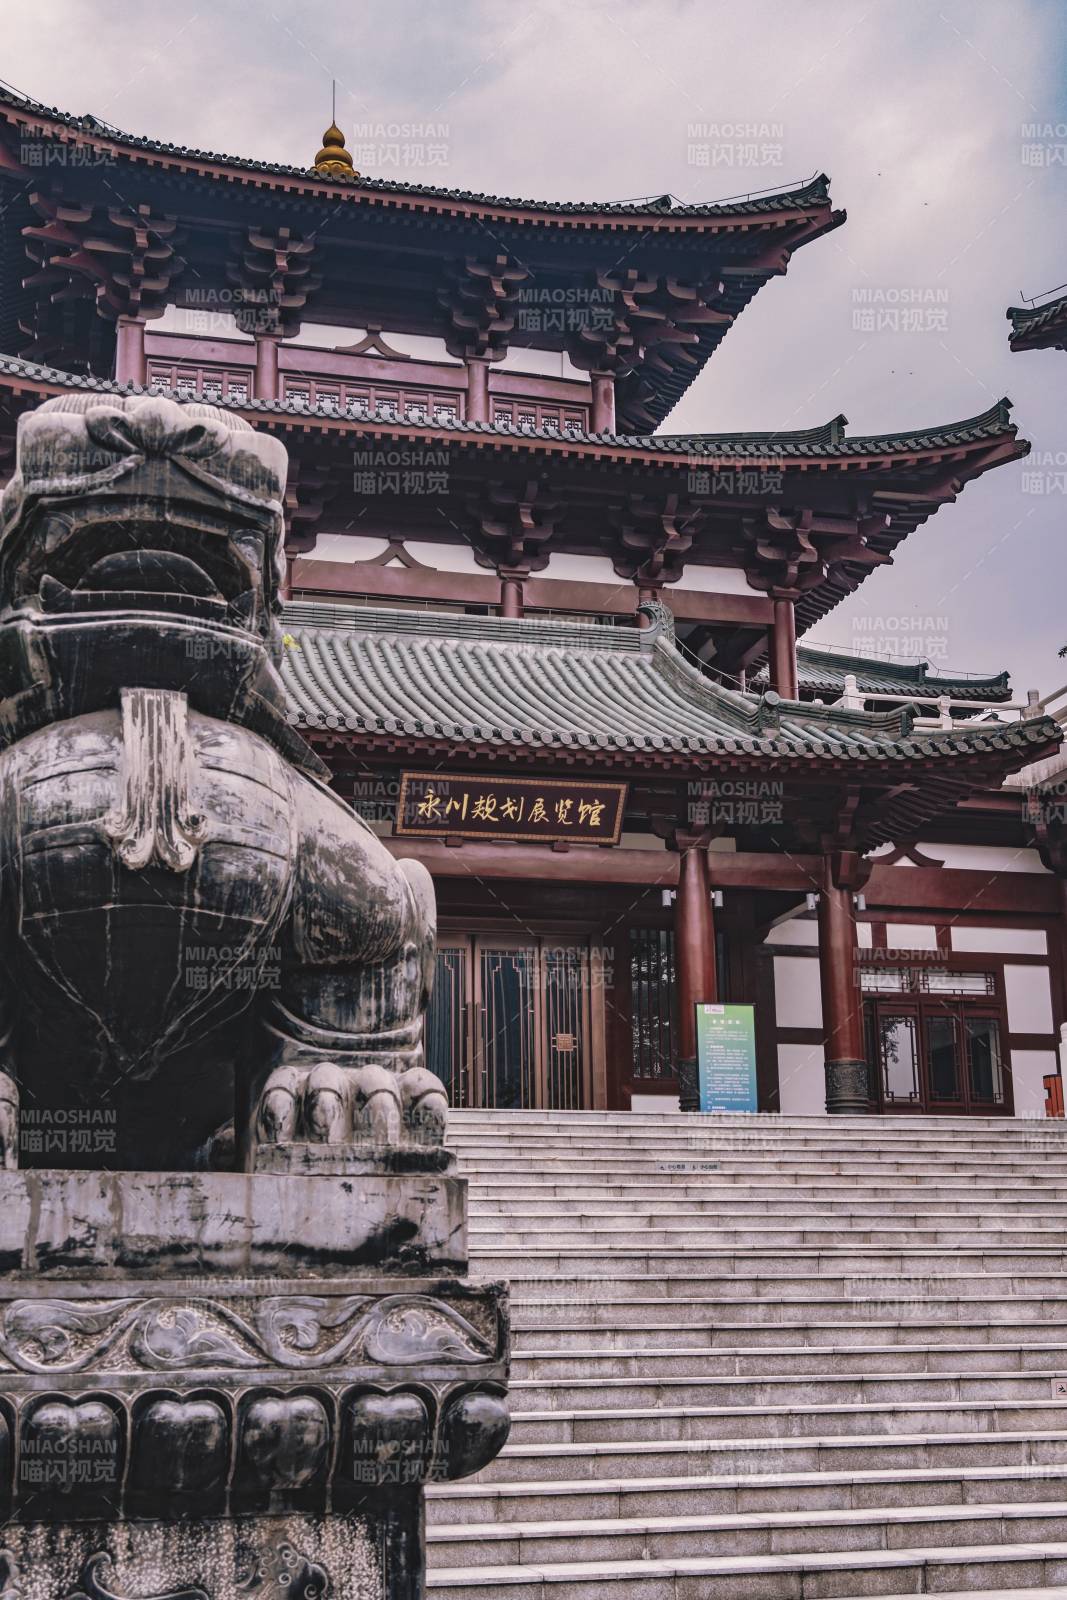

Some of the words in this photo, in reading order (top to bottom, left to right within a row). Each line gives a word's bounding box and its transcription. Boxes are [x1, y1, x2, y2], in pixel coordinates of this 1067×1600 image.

[417, 788, 606, 826] 永川规划展览馆
